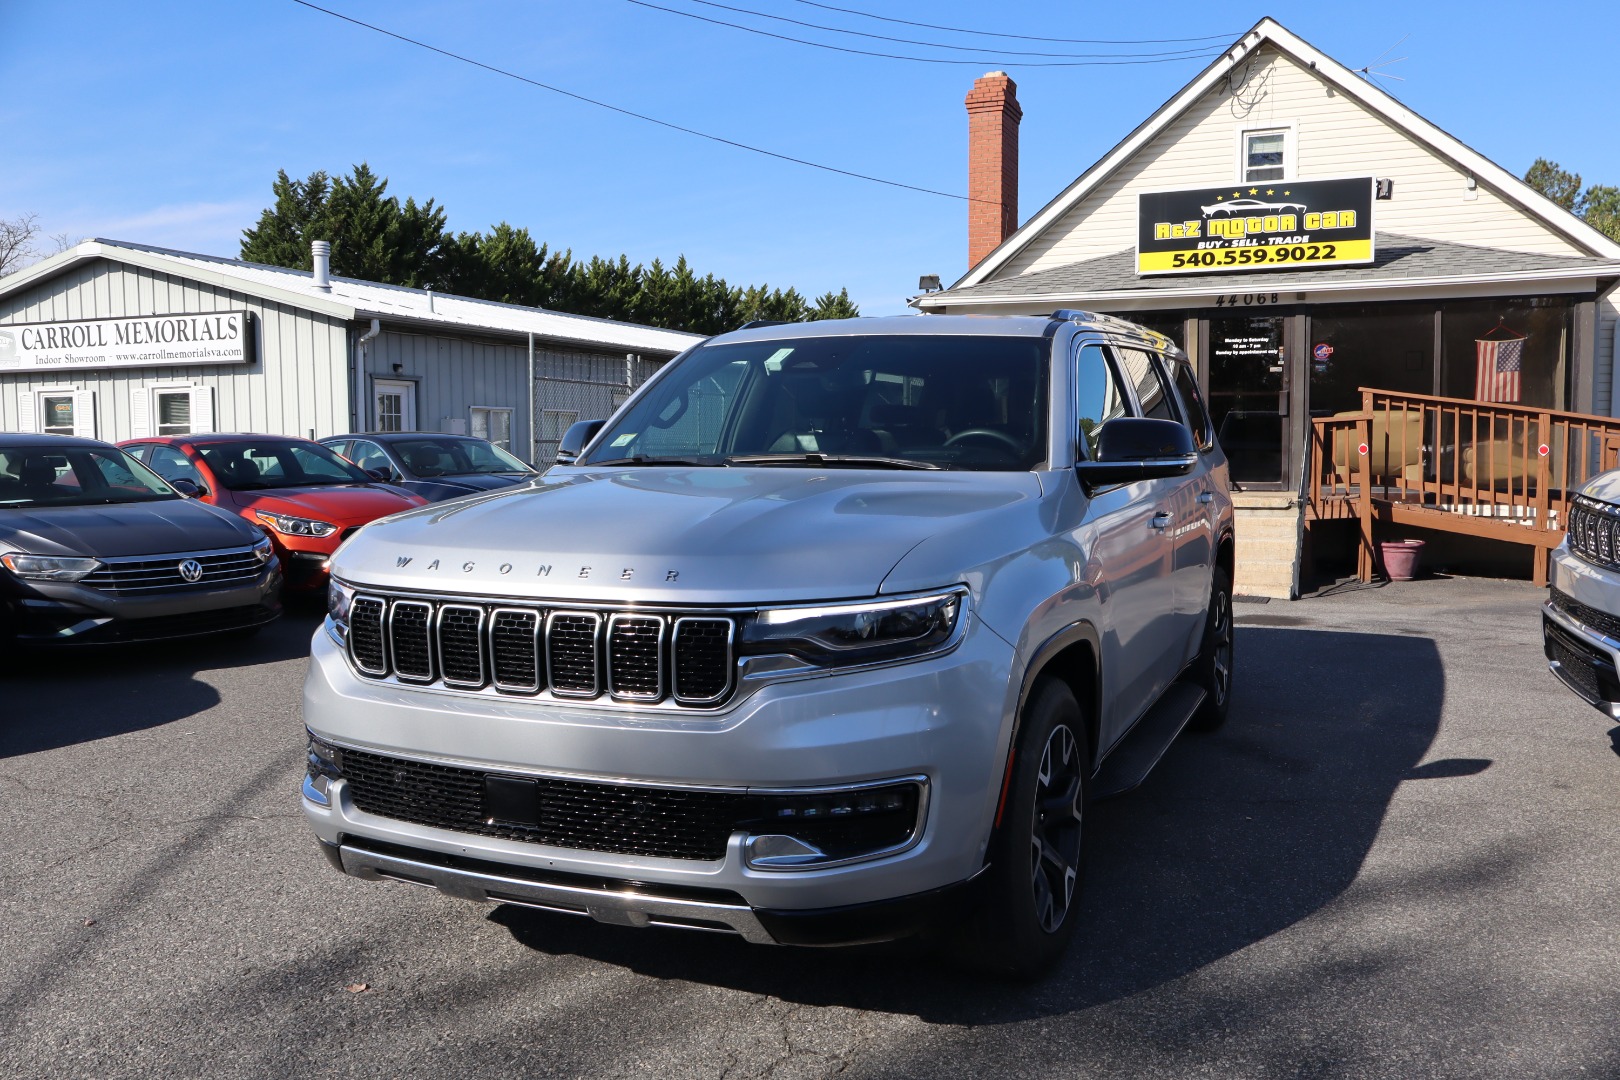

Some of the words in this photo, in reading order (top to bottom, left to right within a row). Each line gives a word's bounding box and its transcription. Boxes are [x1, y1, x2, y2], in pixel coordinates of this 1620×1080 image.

[1155, 220, 1201, 240] R&Z
[1197, 240, 1223, 250] BUY
[1231, 238, 1259, 248] SELL
[1268, 235, 1310, 246] TRADE
[1172, 244, 1337, 268] 540.559.9022
[1215, 292, 1278, 307] 4406B
[21, 324, 108, 351] CARROLL
[114, 316, 239, 346] MEMORIALS
[35, 355, 62, 365] Indoor
[64, 353, 106, 364] Showroom
[116, 348, 242, 361] www.carrollmemorialsva.com
[395, 556, 680, 582] WAGONEER
